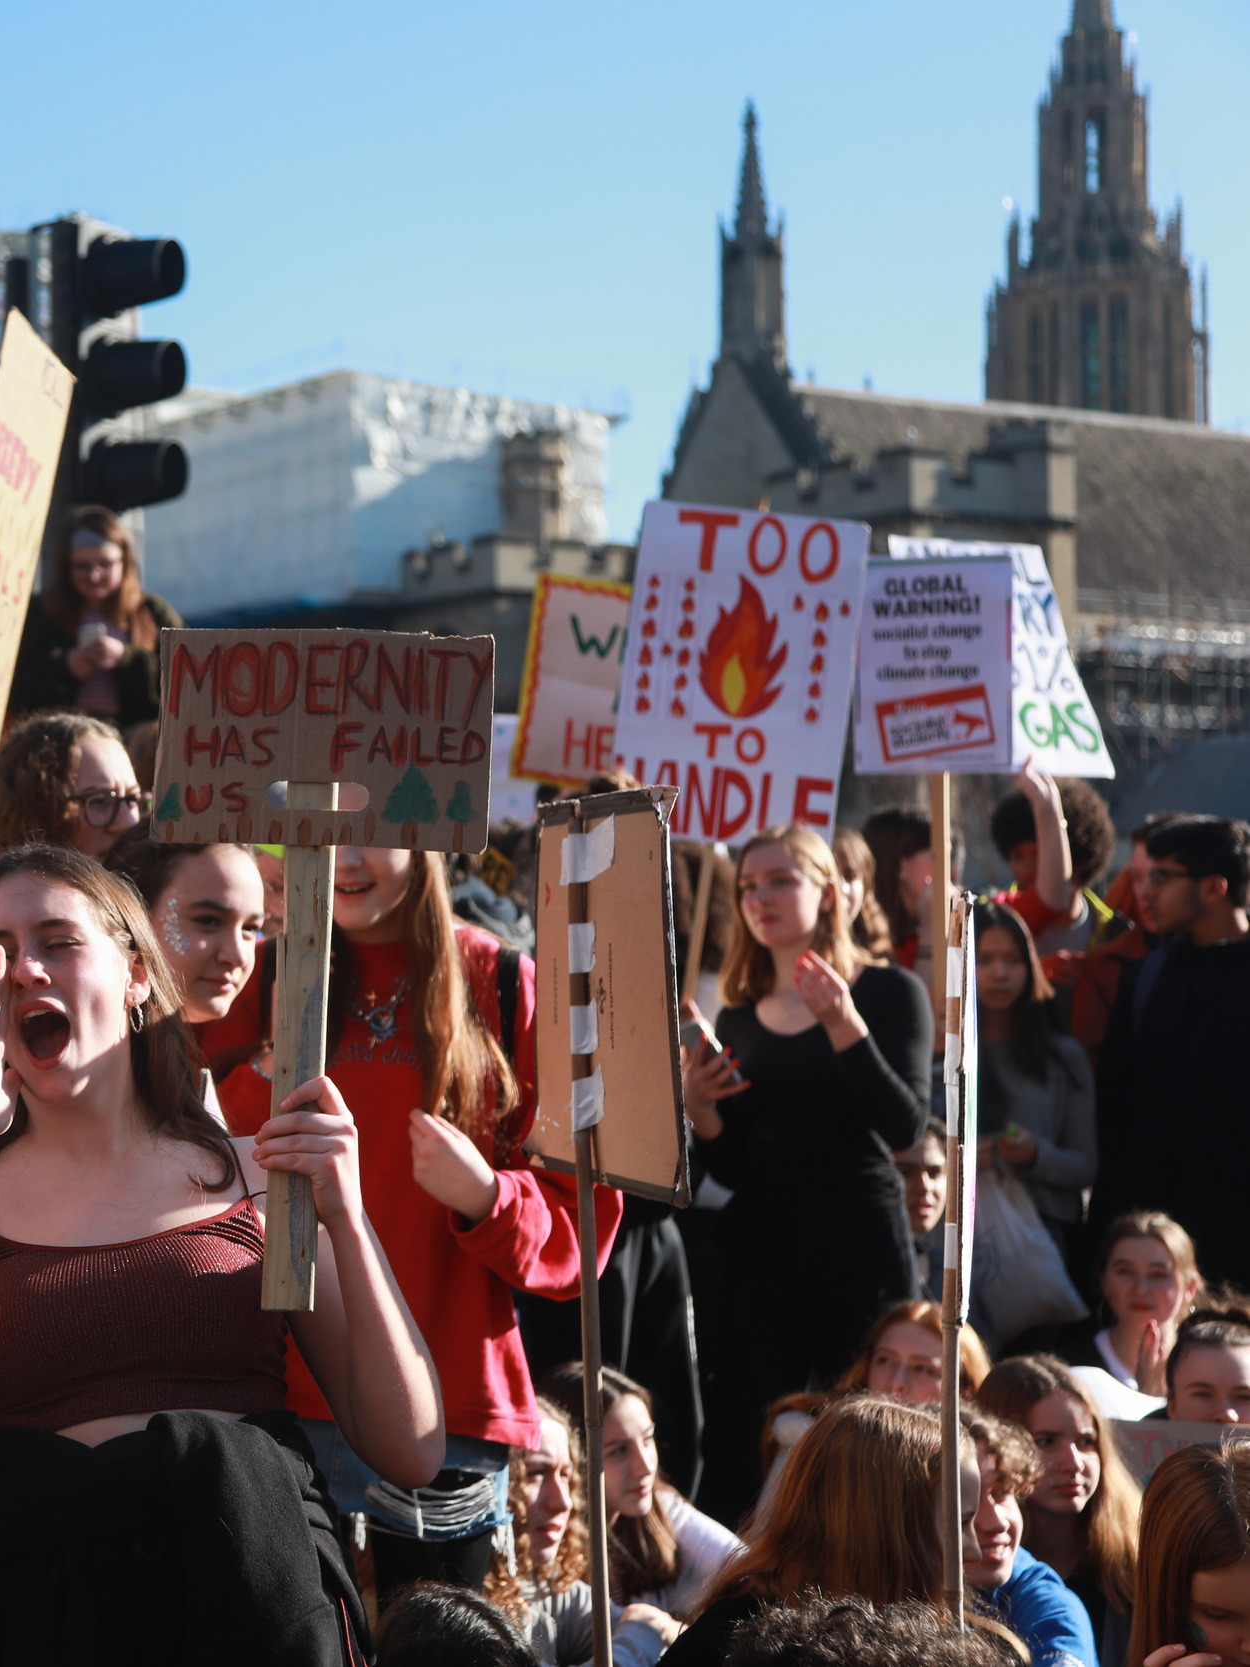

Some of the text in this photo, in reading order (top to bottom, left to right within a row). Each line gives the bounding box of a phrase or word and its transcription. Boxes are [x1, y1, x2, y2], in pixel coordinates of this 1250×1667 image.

[678, 509, 841, 584] TOO
[884, 574, 966, 597] GLOBAL
[872, 594, 981, 619] WARNING!
[872, 622, 983, 642] socialist change
[903, 645, 952, 662] to stop
[168, 637, 494, 731] MODERNITY
[876, 663, 980, 682] climate change
[694, 723, 767, 764] TO
[1019, 701, 1101, 753] GAS
[184, 721, 487, 775] HAS FAILED
[184, 781, 251, 815] US
